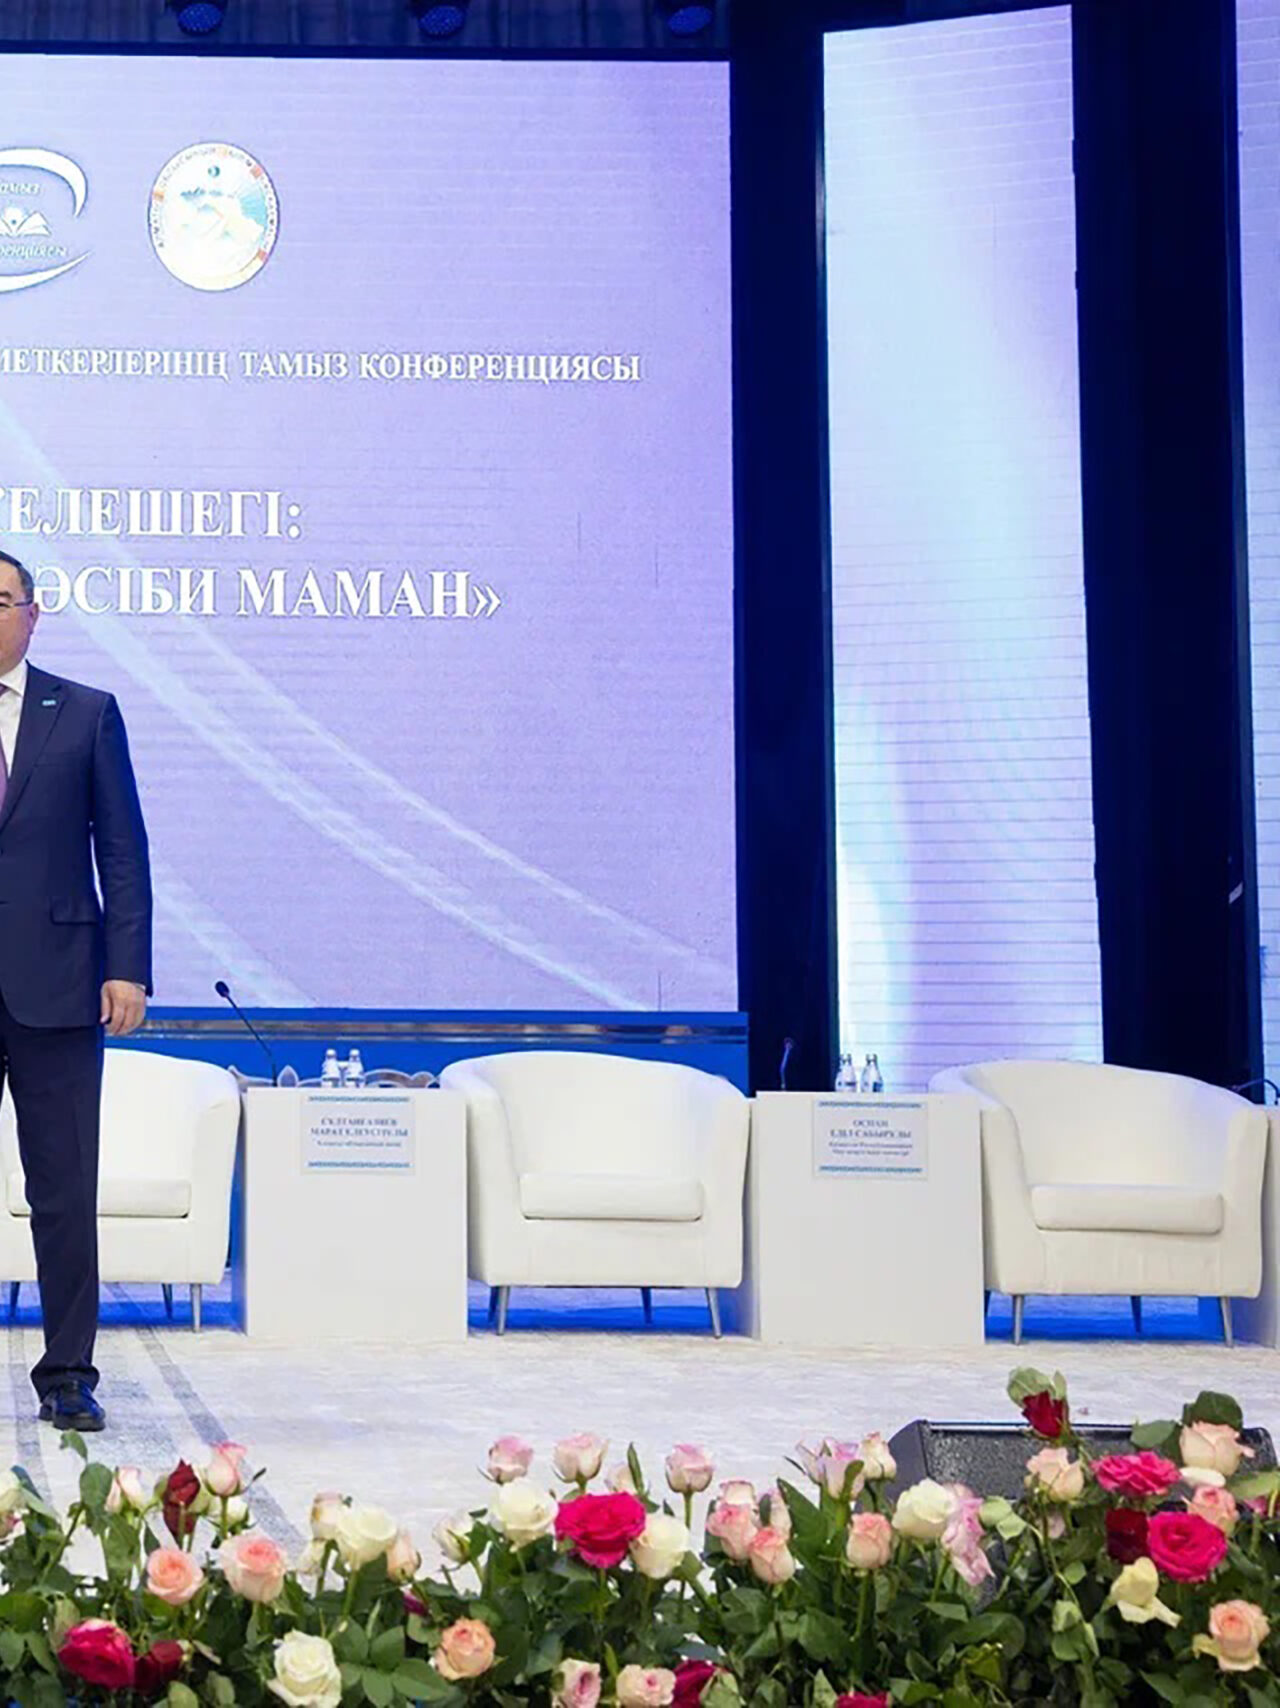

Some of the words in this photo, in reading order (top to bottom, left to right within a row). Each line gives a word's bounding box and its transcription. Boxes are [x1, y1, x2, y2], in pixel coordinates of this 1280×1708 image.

[241, 352, 349, 378] ТАМЫЗ
[359, 353, 641, 384] КОНФЕРЕНЦИЯСЫ
[35, 567, 217, 617] ӘСІБИ
[236, 569, 503, 618] МАМАН»
